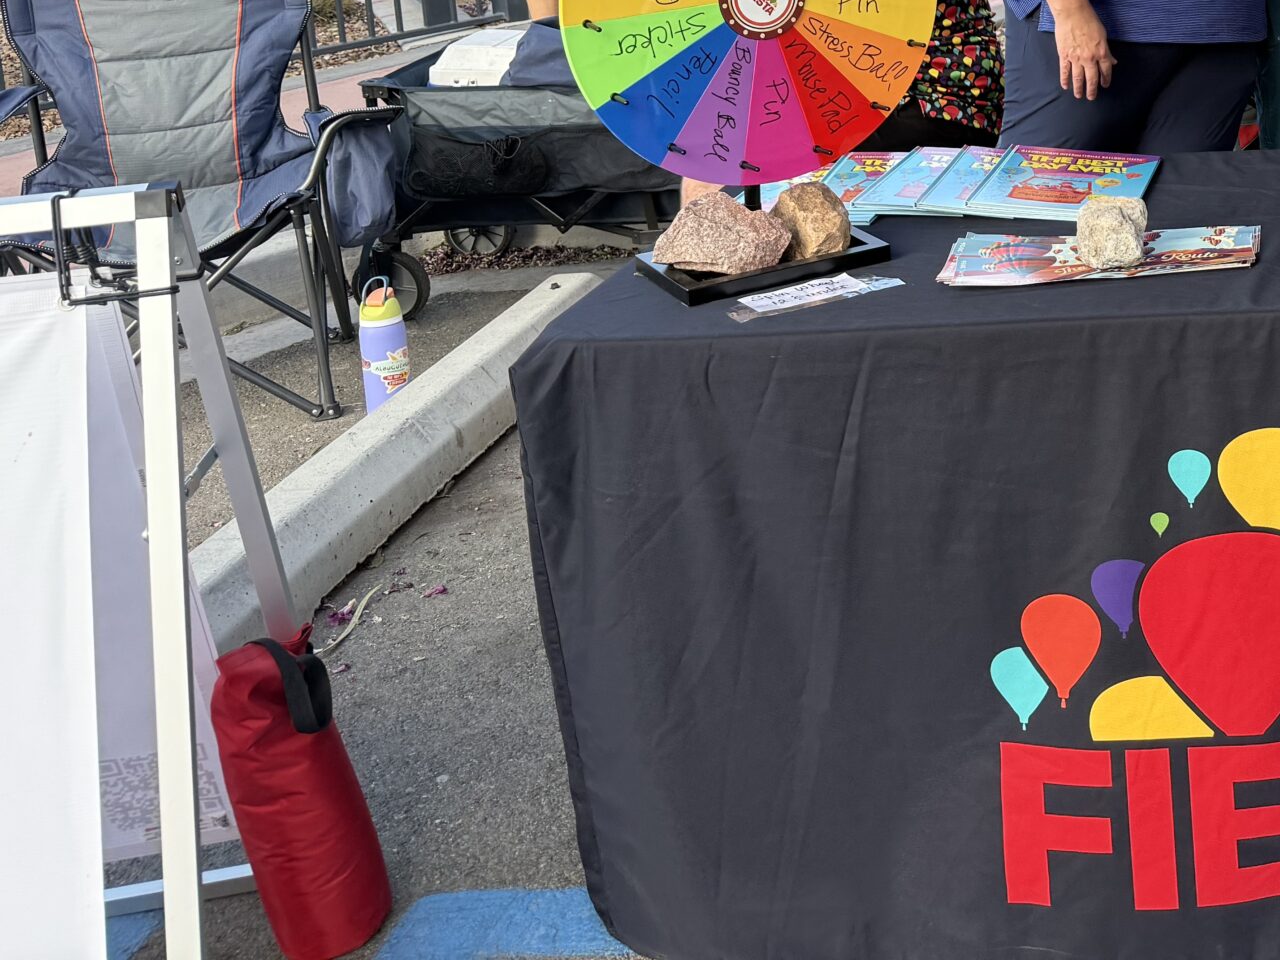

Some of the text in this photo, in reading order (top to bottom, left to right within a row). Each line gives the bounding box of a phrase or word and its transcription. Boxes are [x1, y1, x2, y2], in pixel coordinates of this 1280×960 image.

[610, 12, 707, 58] Sticker
[802, 17, 854, 58] Stress
[647, 47, 718, 120] Pencil
[703, 39, 751, 162] Bouncy Ball
[759, 77, 790, 127] Pin
[817, 91, 860, 135] Pad
[1019, 160, 1129, 175] DAY EVER!
[1028, 154, 1129, 168] THE BEST
[1053, 263, 1087, 275] The
[1160, 250, 1220, 263] Route
